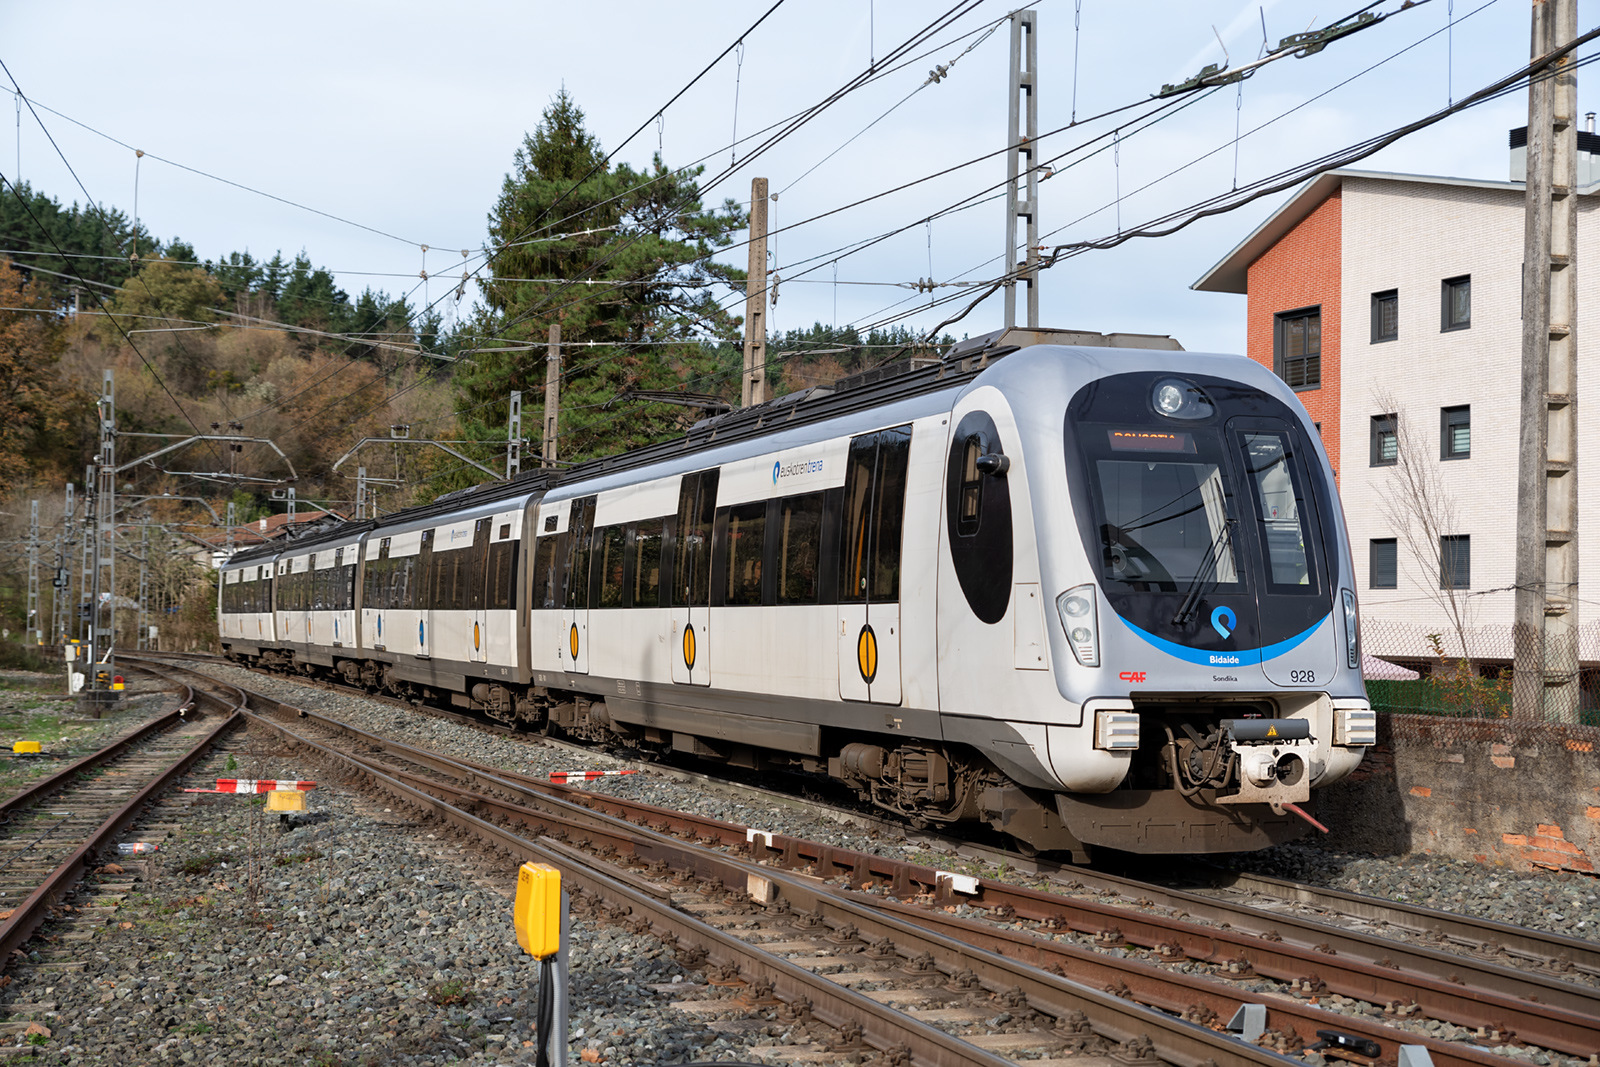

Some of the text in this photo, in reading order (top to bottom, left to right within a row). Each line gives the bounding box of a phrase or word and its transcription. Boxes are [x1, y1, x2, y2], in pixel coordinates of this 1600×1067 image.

[1209, 655, 1239, 664] Bidaide
[1119, 671, 1147, 683] CAF
[1290, 670, 1316, 683] 928
